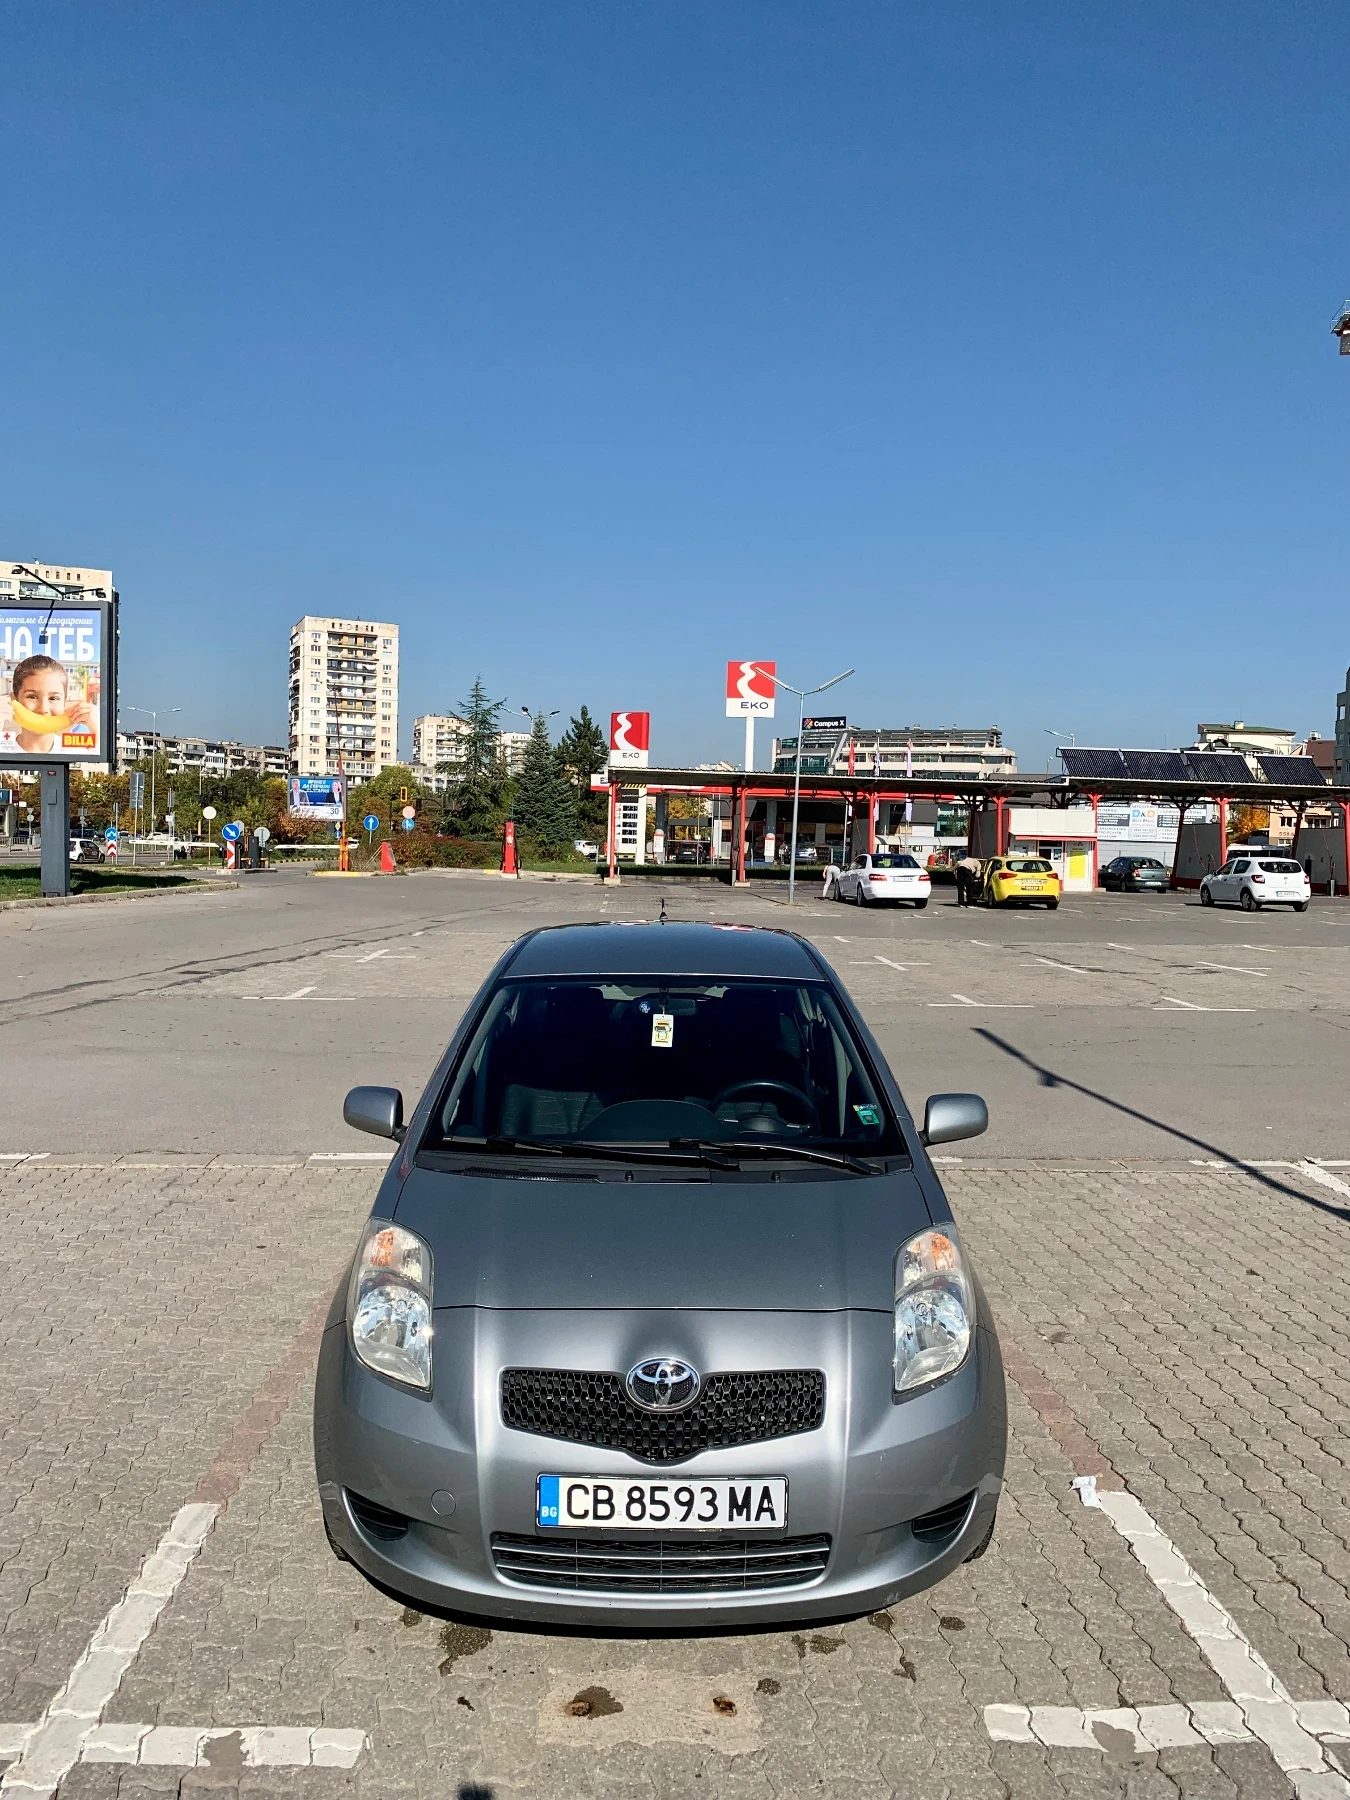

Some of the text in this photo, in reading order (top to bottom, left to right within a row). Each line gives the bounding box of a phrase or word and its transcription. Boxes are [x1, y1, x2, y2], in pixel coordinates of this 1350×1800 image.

[0, 615, 36, 624] омагаме
[38, 627, 95, 662] ТЕБ
[740, 701, 769, 709] EKO
[813, 720, 839, 728] Campus
[63, 735, 94, 746] BILLA
[541, 1484, 777, 1522] BG CB 8593 MA
